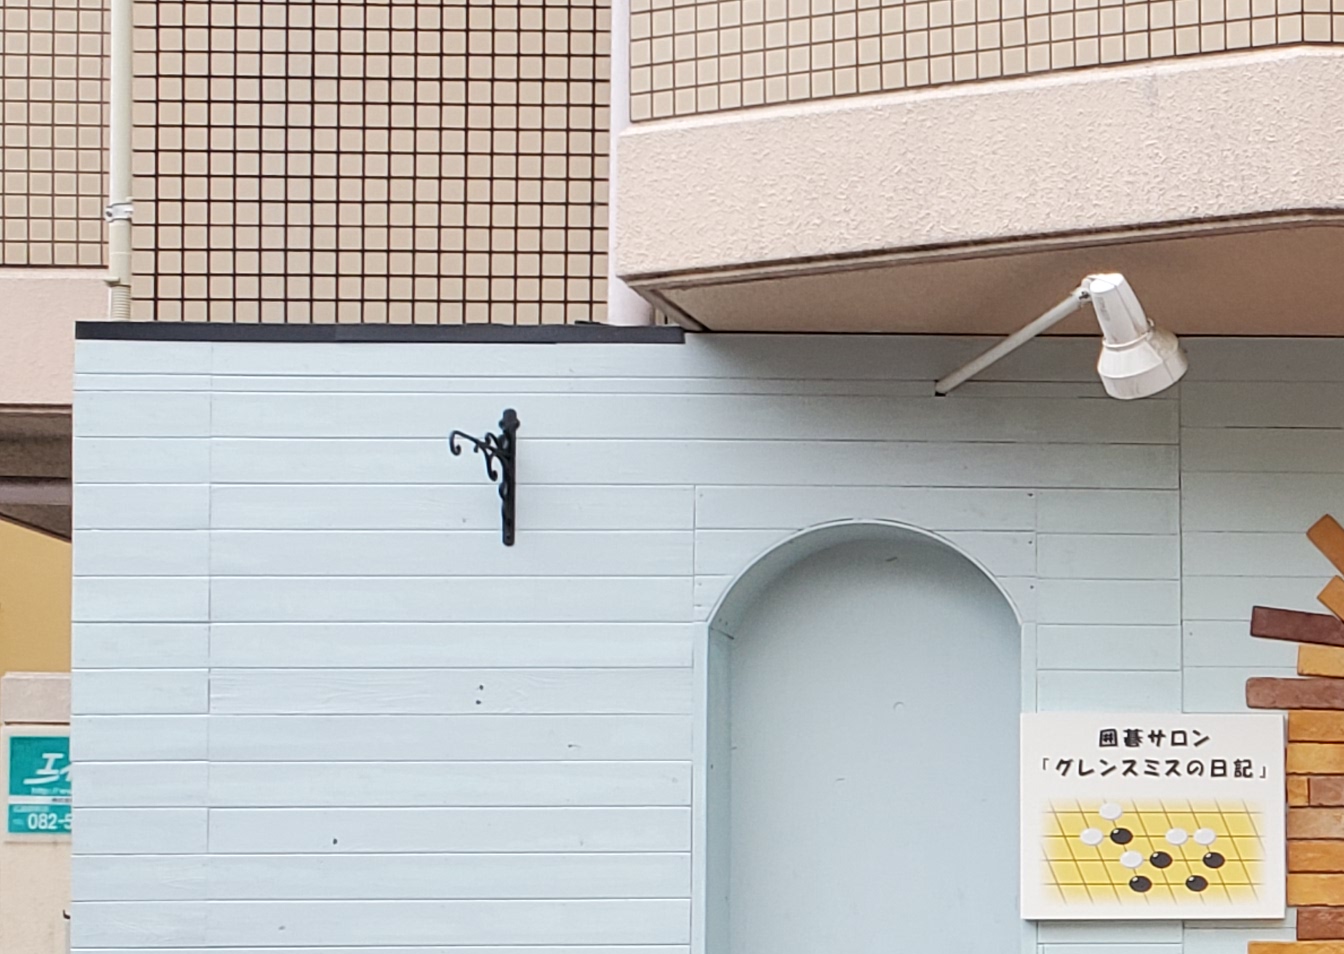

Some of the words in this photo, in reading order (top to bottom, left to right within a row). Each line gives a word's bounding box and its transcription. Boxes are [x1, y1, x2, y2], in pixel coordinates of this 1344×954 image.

[1098, 728, 1210, 748] 囲碁サロン
[1041, 757, 1267, 779] 「グレンスミスの日記」
